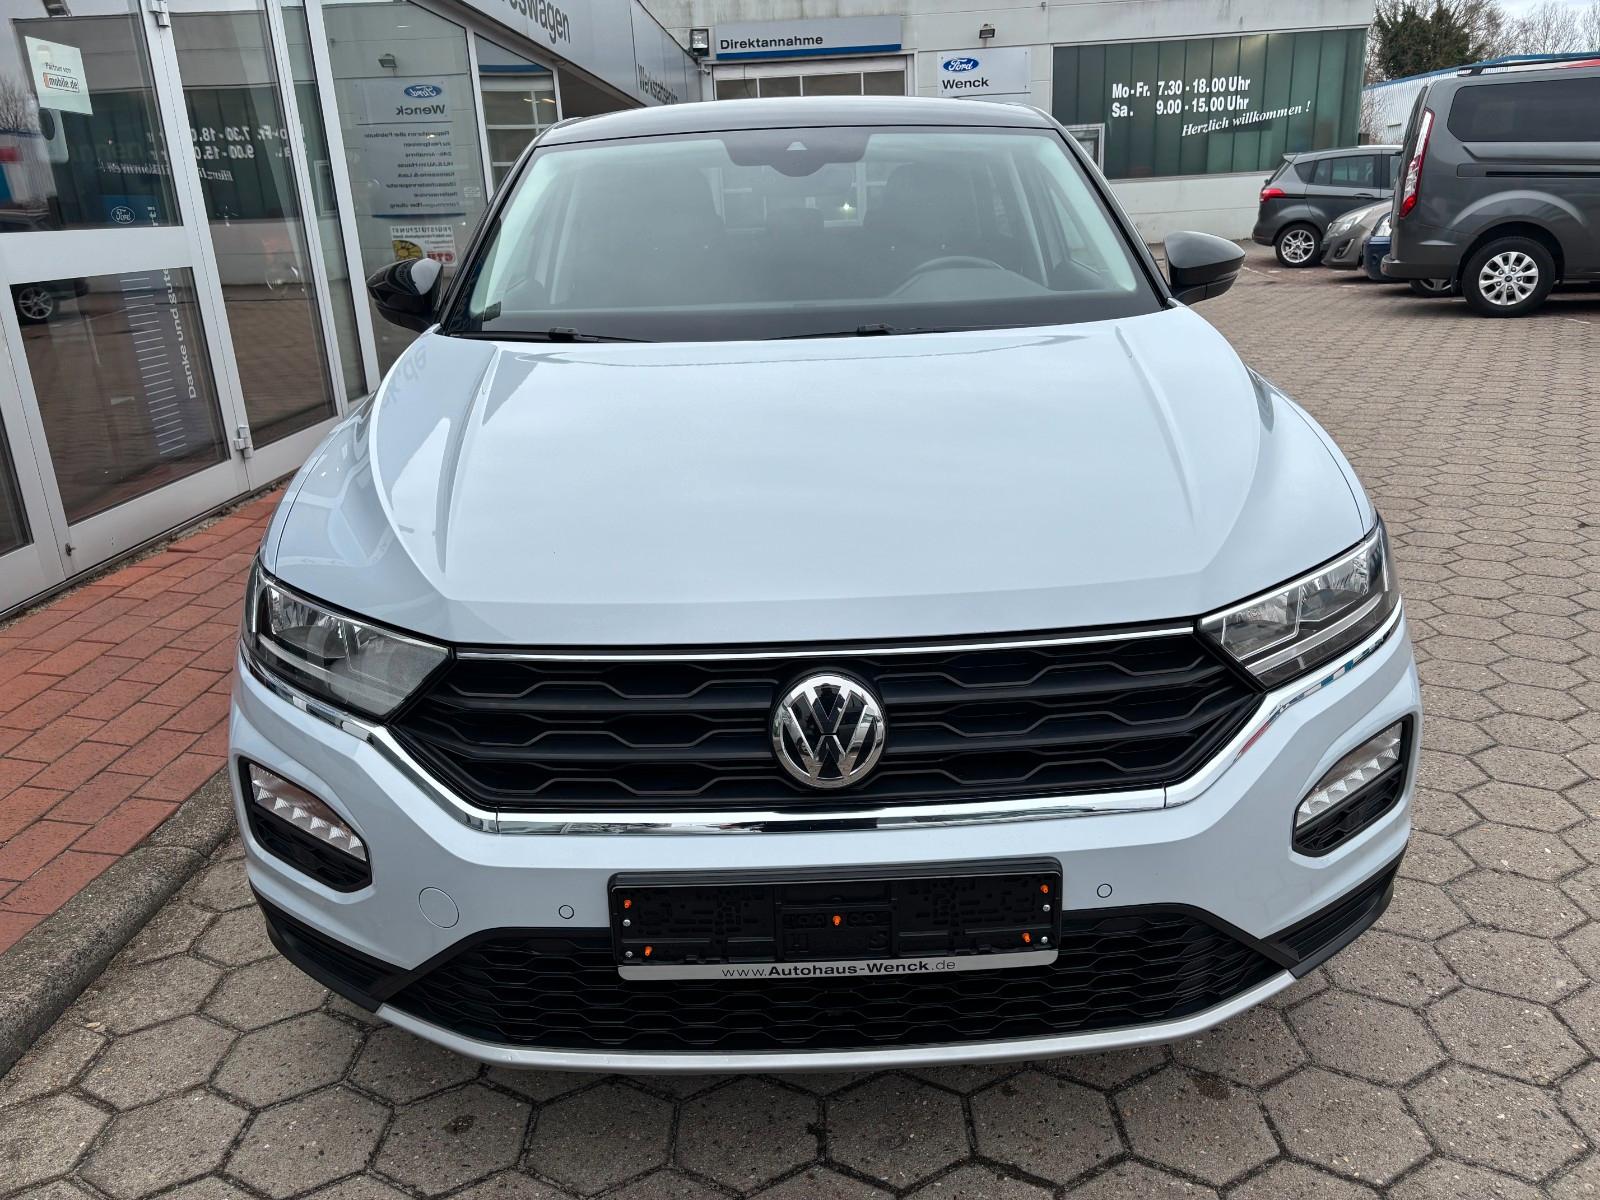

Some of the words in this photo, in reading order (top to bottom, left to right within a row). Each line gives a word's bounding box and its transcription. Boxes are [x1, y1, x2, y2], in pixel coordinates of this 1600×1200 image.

[509, 0, 571, 45] swagen
[720, 36, 824, 50] Direktannahme
[941, 76, 990, 90] Wenck
[1157, 79, 1183, 96] 7.30
[1228, 75, 1251, 91] Uhr
[1156, 99, 1182, 115] 9.00
[1227, 95, 1249, 110] Uhr
[1182, 117, 1230, 137] Herzlich
[1232, 105, 1302, 127] willkommen
[170, 308, 184, 343] und
[180, 344, 197, 400] Danke
[721, 959, 956, 978] www.Autohaus-Wenck.de
